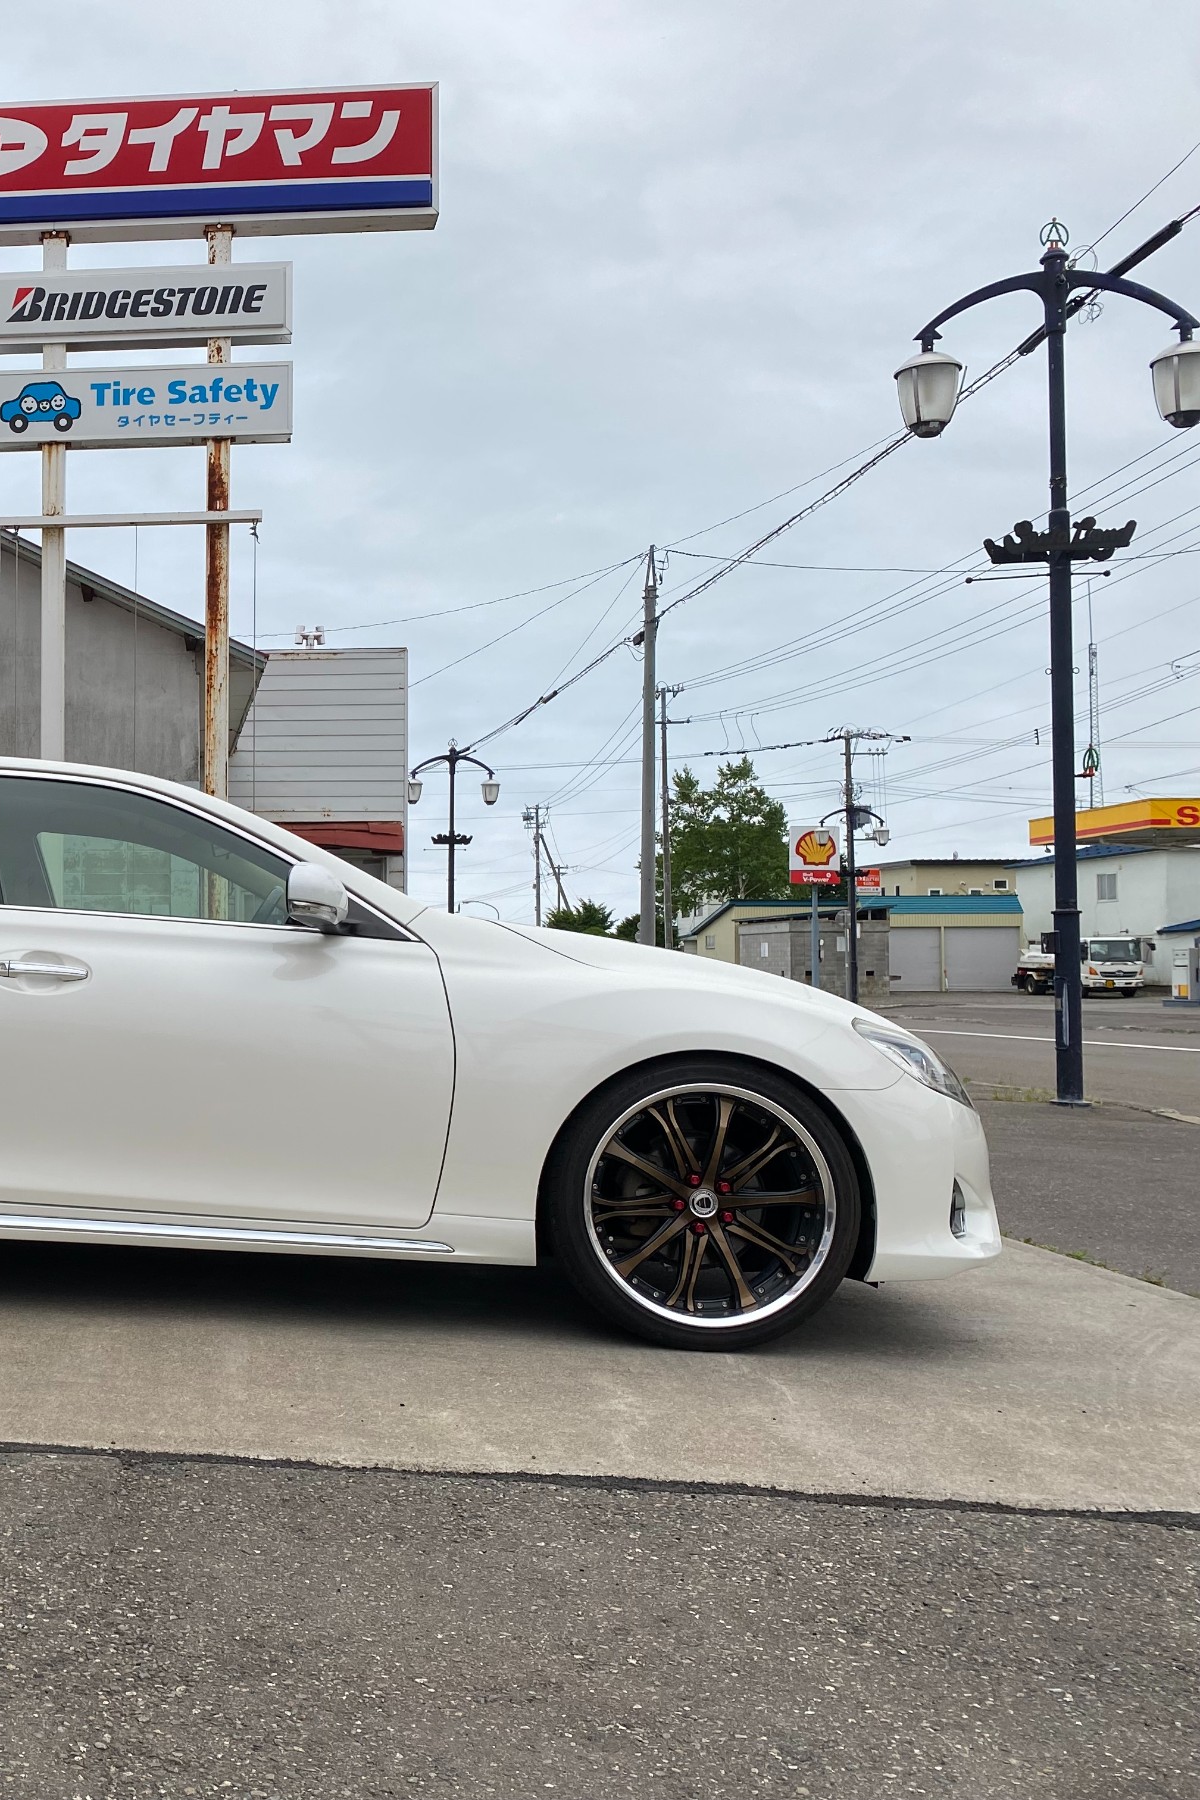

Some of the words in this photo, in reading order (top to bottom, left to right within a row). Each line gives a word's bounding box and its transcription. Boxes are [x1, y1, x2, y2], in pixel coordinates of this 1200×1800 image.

[60, 100, 401, 176] タイヤマン
[5, 284, 268, 323] BRIDGESTONE
[90, 380, 156, 407] Tire
[167, 377, 280, 410] Safety
[117, 413, 248, 428] タイヤセーフティー
